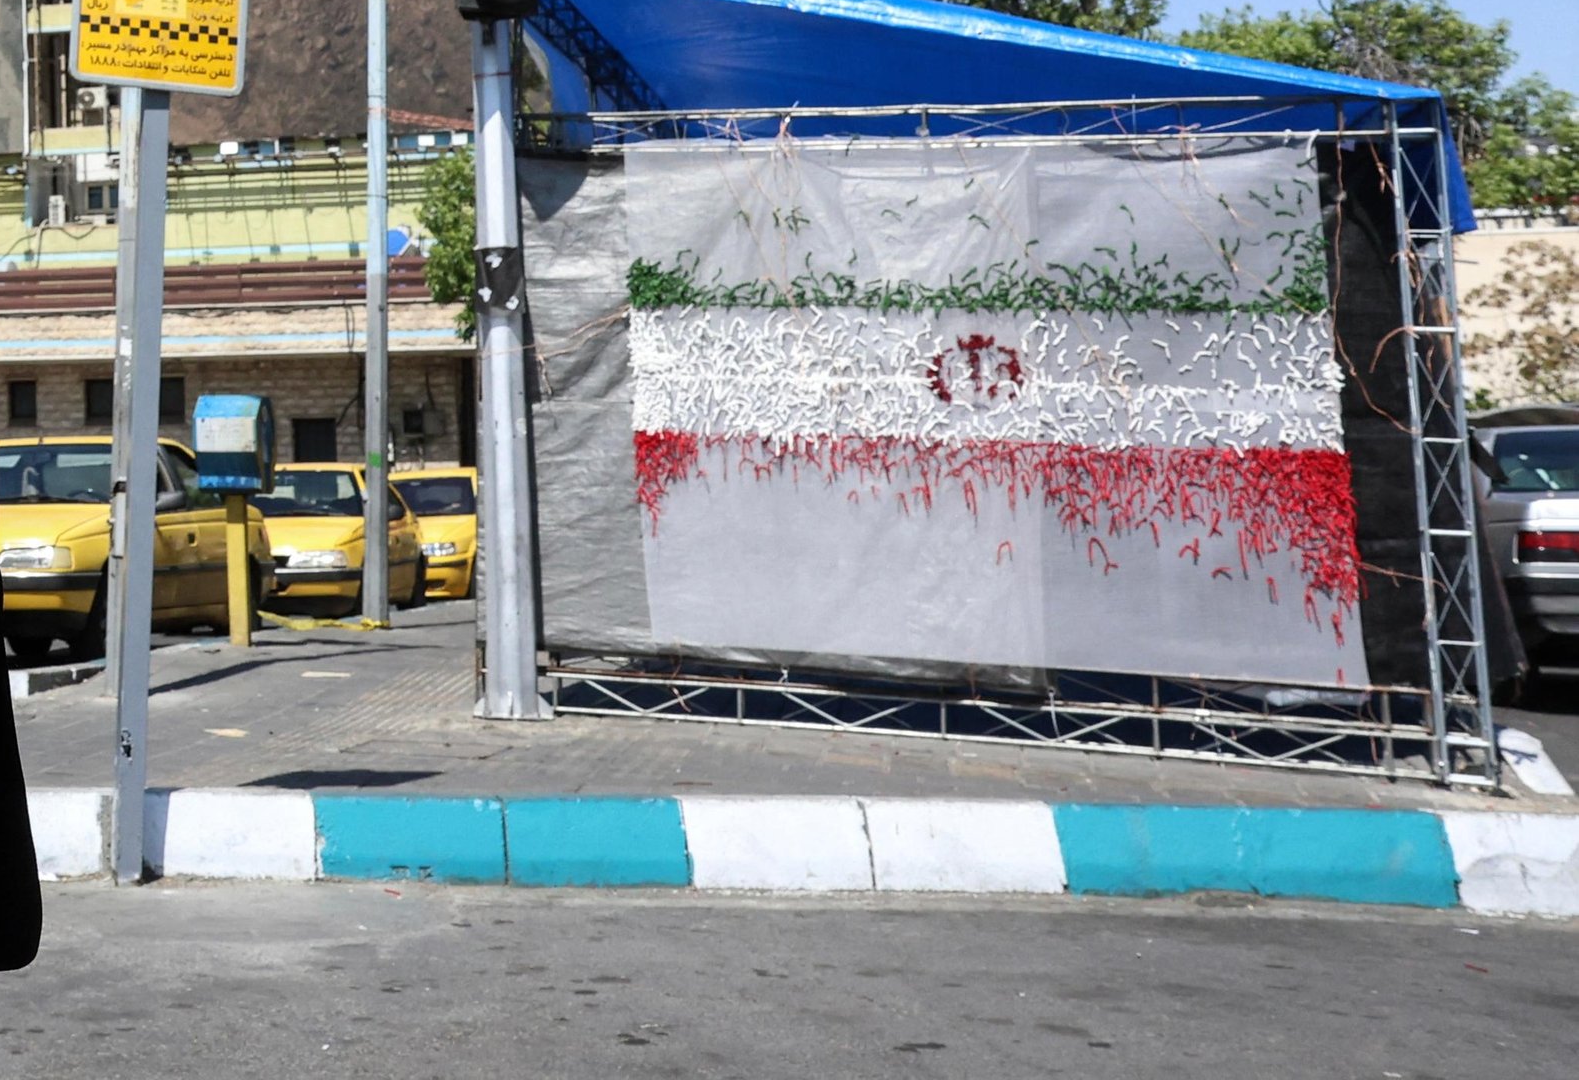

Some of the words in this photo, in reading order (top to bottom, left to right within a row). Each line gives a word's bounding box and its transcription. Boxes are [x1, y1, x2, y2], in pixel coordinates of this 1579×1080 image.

[87, 0, 109, 10] ریال
[178, 48, 188, 58] به
[190, 52, 233, 63] دسترسی
